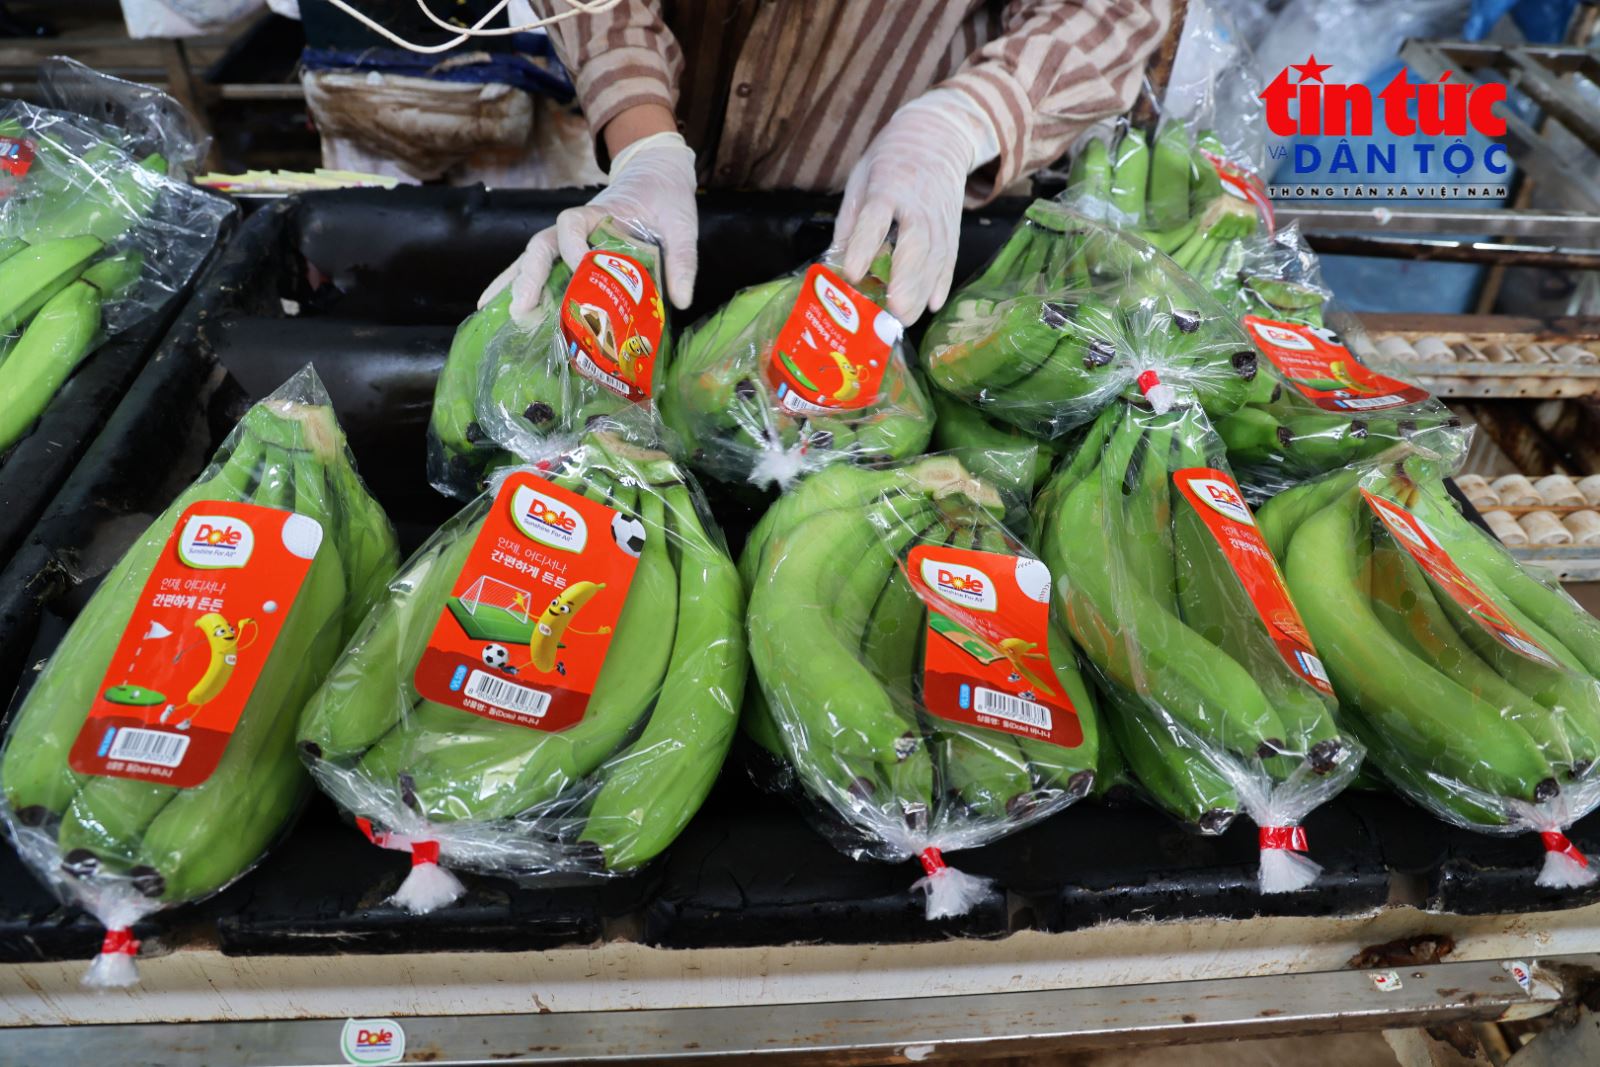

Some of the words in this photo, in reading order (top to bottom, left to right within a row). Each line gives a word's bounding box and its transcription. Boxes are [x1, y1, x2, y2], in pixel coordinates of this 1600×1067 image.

[608, 259, 638, 284] Dole
[825, 287, 852, 316] Dole
[1206, 485, 1241, 506] Dole
[528, 499, 576, 530] Dole
[194, 524, 242, 545] Dole
[497, 537, 520, 556] 언제,
[525, 549, 567, 574] 어디서나
[491, 549, 540, 579] 간편하게
[542, 571, 567, 591] 든든
[938, 569, 983, 592] Dole
[184, 579, 226, 595] 어디서나
[152, 593, 197, 609] 간편하게
[197, 596, 224, 613] 든든
[357, 1028, 392, 1044] Dole
